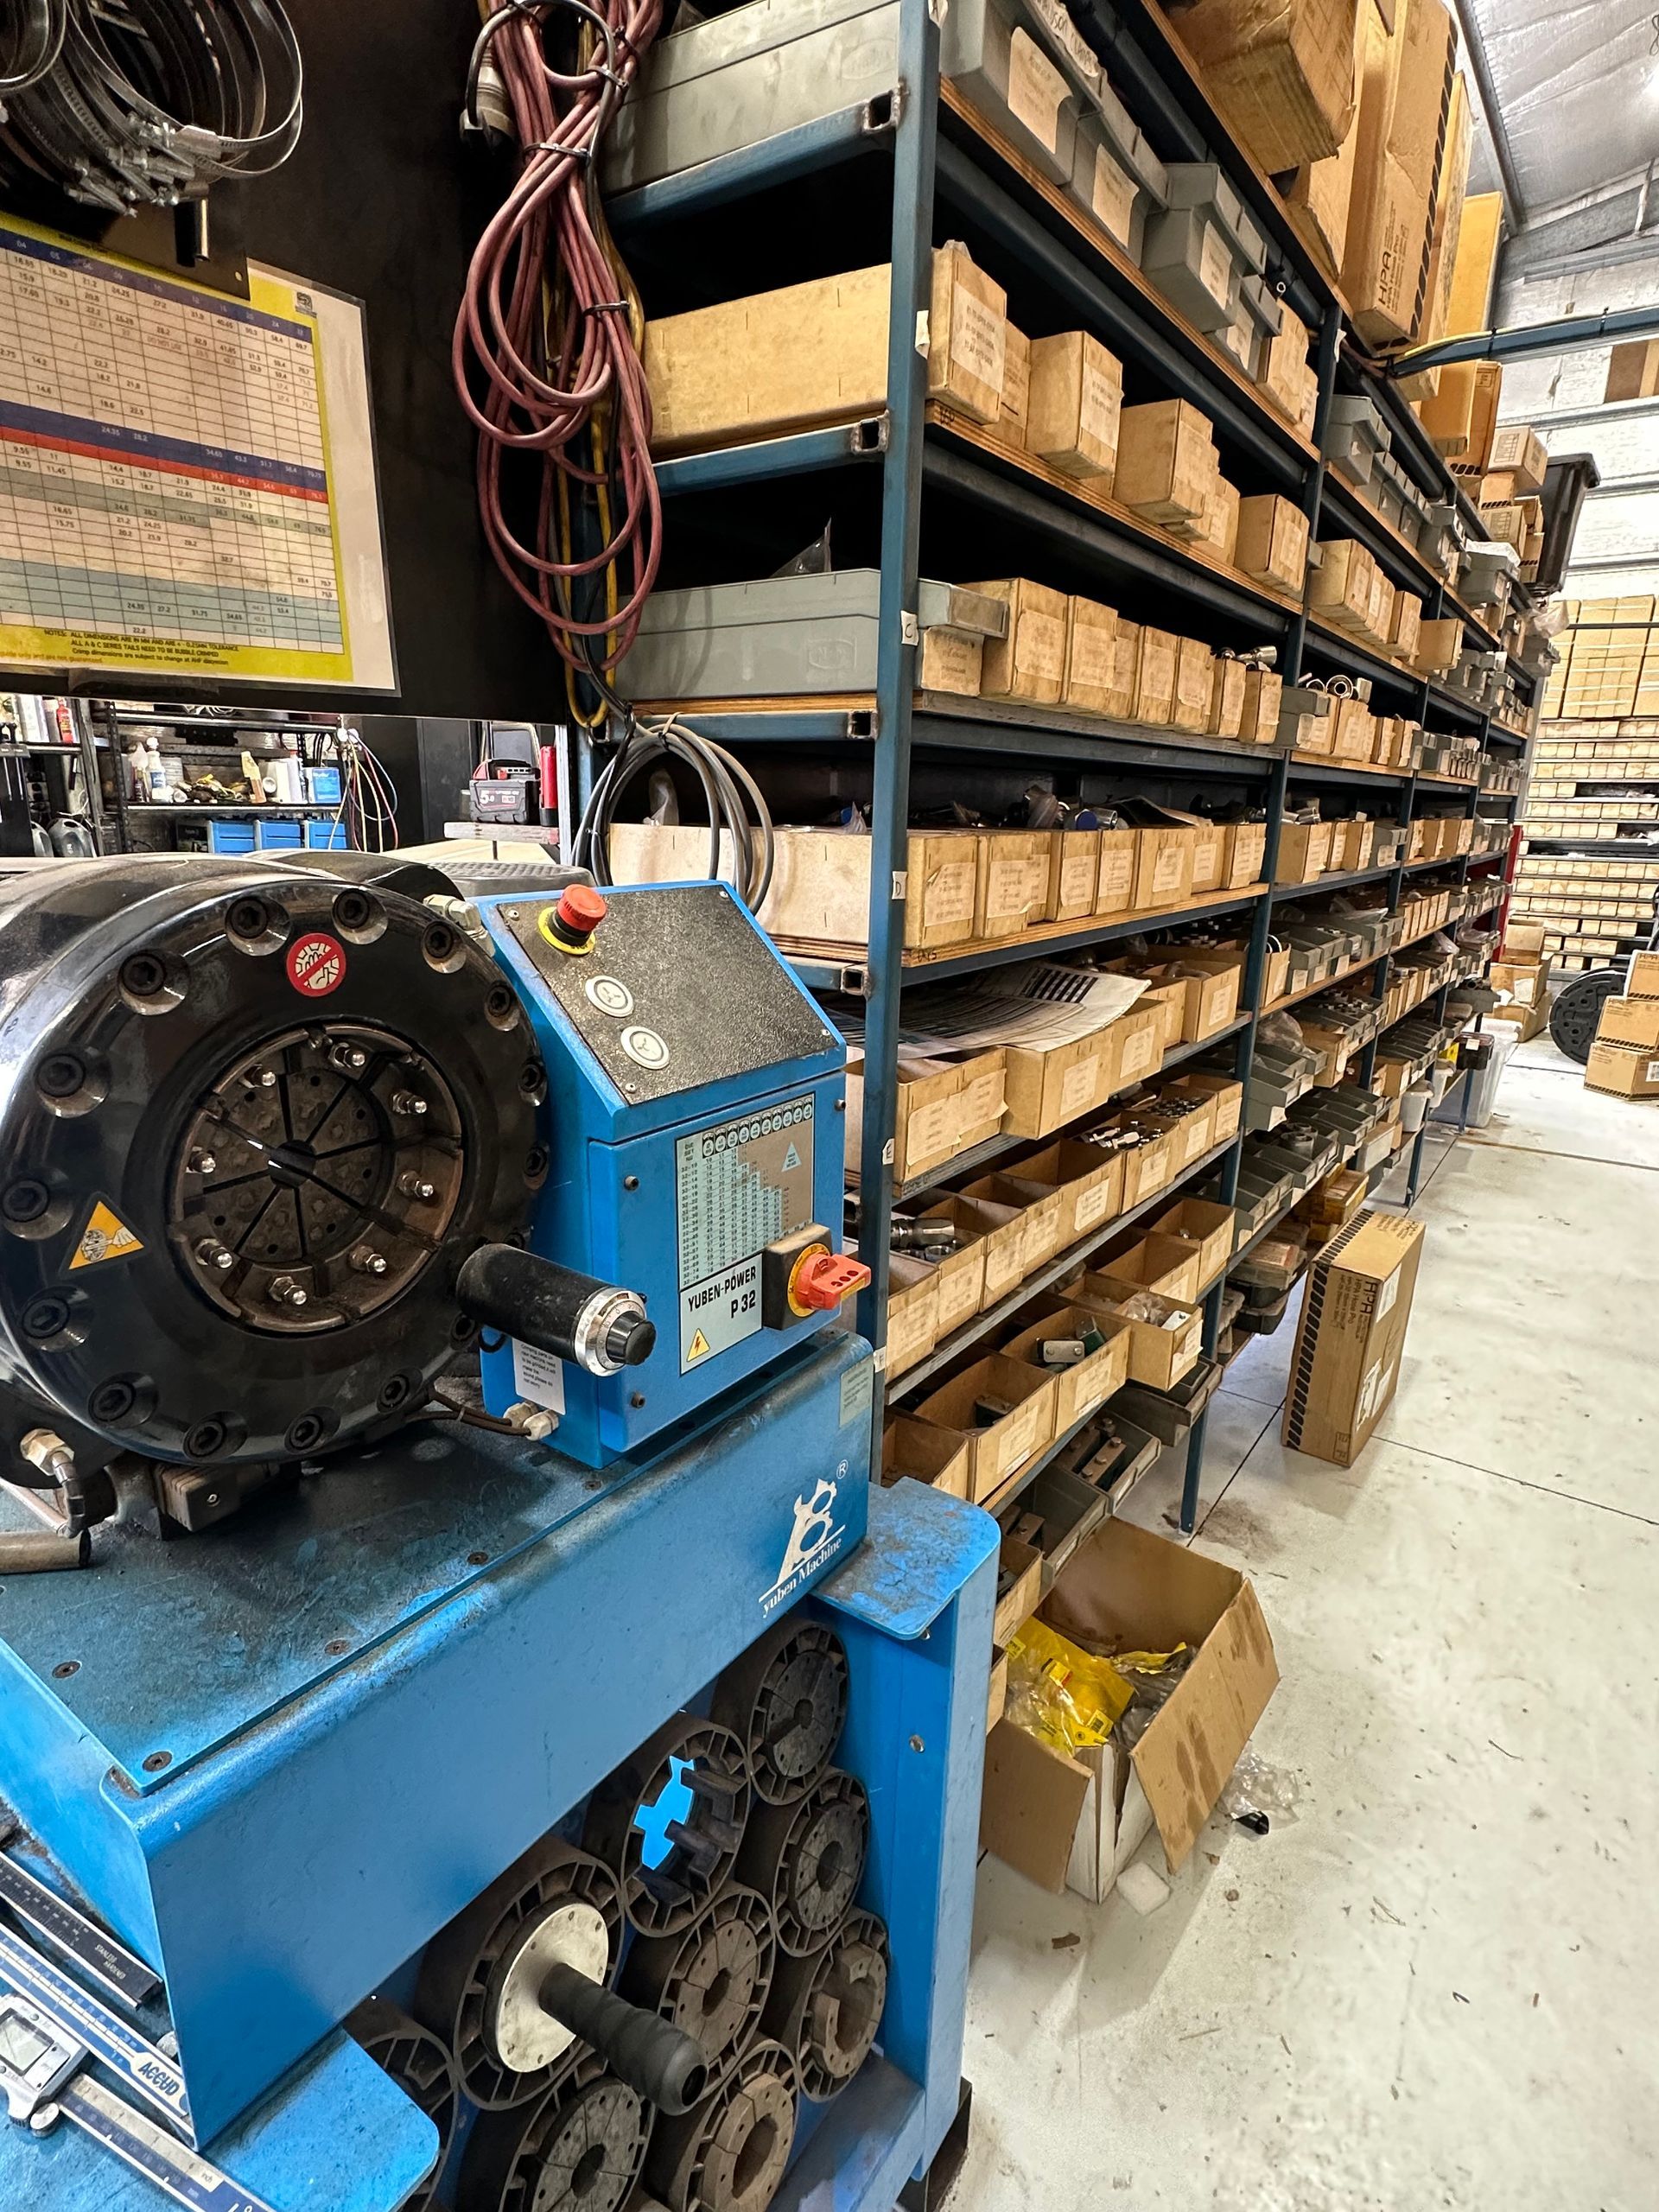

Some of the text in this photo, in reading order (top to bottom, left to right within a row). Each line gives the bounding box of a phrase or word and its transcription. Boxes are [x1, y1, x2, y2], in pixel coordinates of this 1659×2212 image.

[1378, 251, 1392, 305] HPA
[84, 633, 119, 642] DIMENSIONS
[688, 1266, 756, 1312] YUBEN-POWER
[730, 1289, 756, 1319] P 32
[1360, 1280, 1378, 1315] HPA
[798, 1537, 842, 1580] Machine
[137, 2060, 181, 2097] ACCUD
